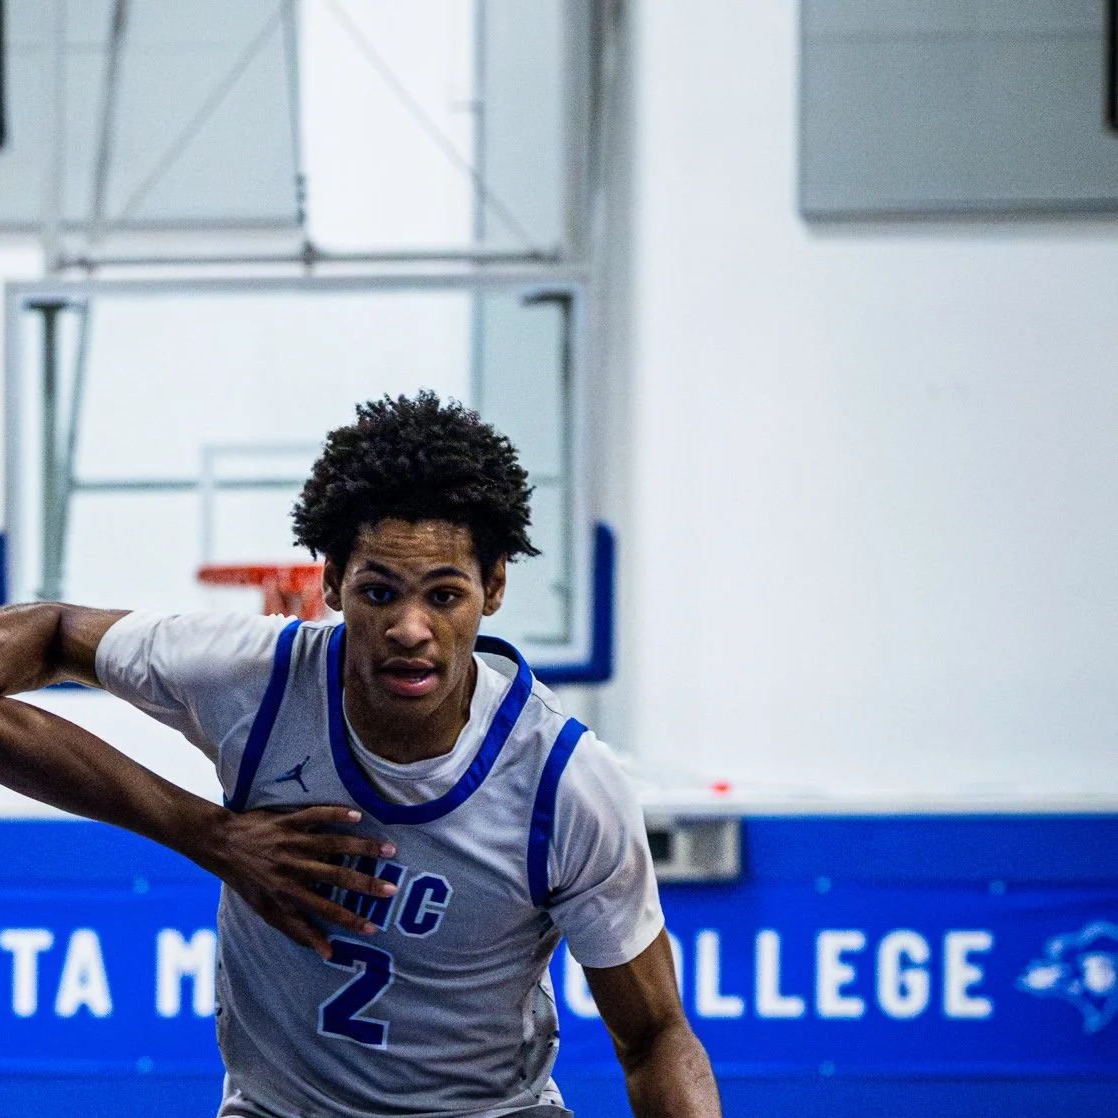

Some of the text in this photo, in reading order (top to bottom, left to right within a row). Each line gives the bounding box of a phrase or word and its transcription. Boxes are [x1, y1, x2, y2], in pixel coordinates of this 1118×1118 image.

[312, 853, 454, 939] MC
[317, 935, 395, 1051] 2
[563, 928, 995, 1020] LLEGE
